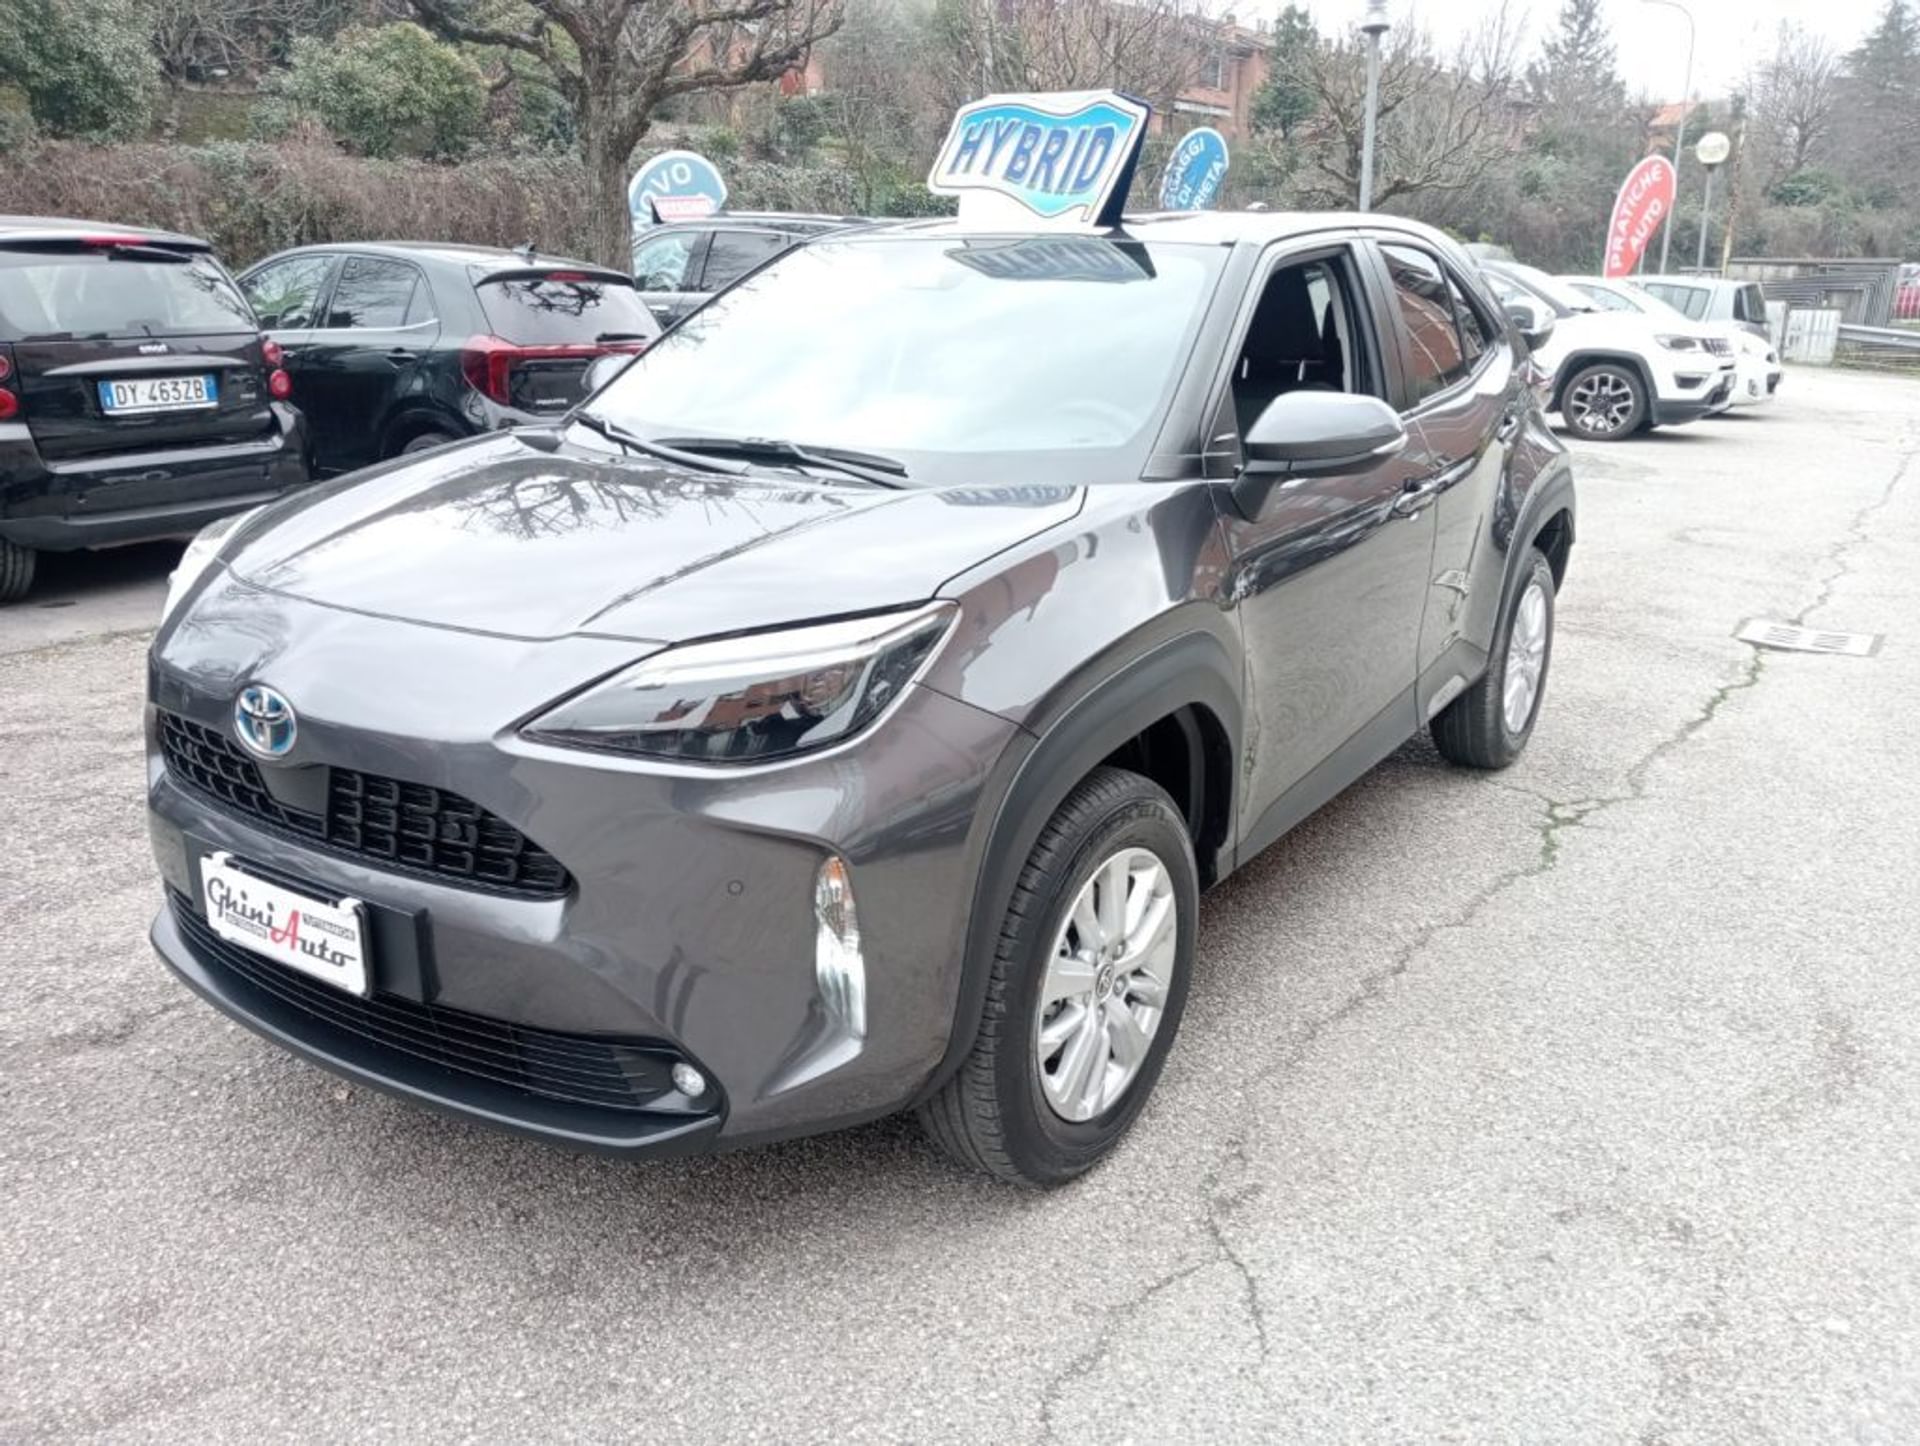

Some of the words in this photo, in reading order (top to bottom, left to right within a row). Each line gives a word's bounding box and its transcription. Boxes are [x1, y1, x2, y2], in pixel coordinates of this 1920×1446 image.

[948, 116, 1116, 195] HYBRID
[1610, 163, 1663, 270] PRATICHE
[1630, 198, 1662, 254] AUTO
[115, 384, 139, 406] DY
[148, 378, 204, 402] 463ZB
[207, 877, 274, 928] Ghini
[270, 910, 357, 967] Auto
